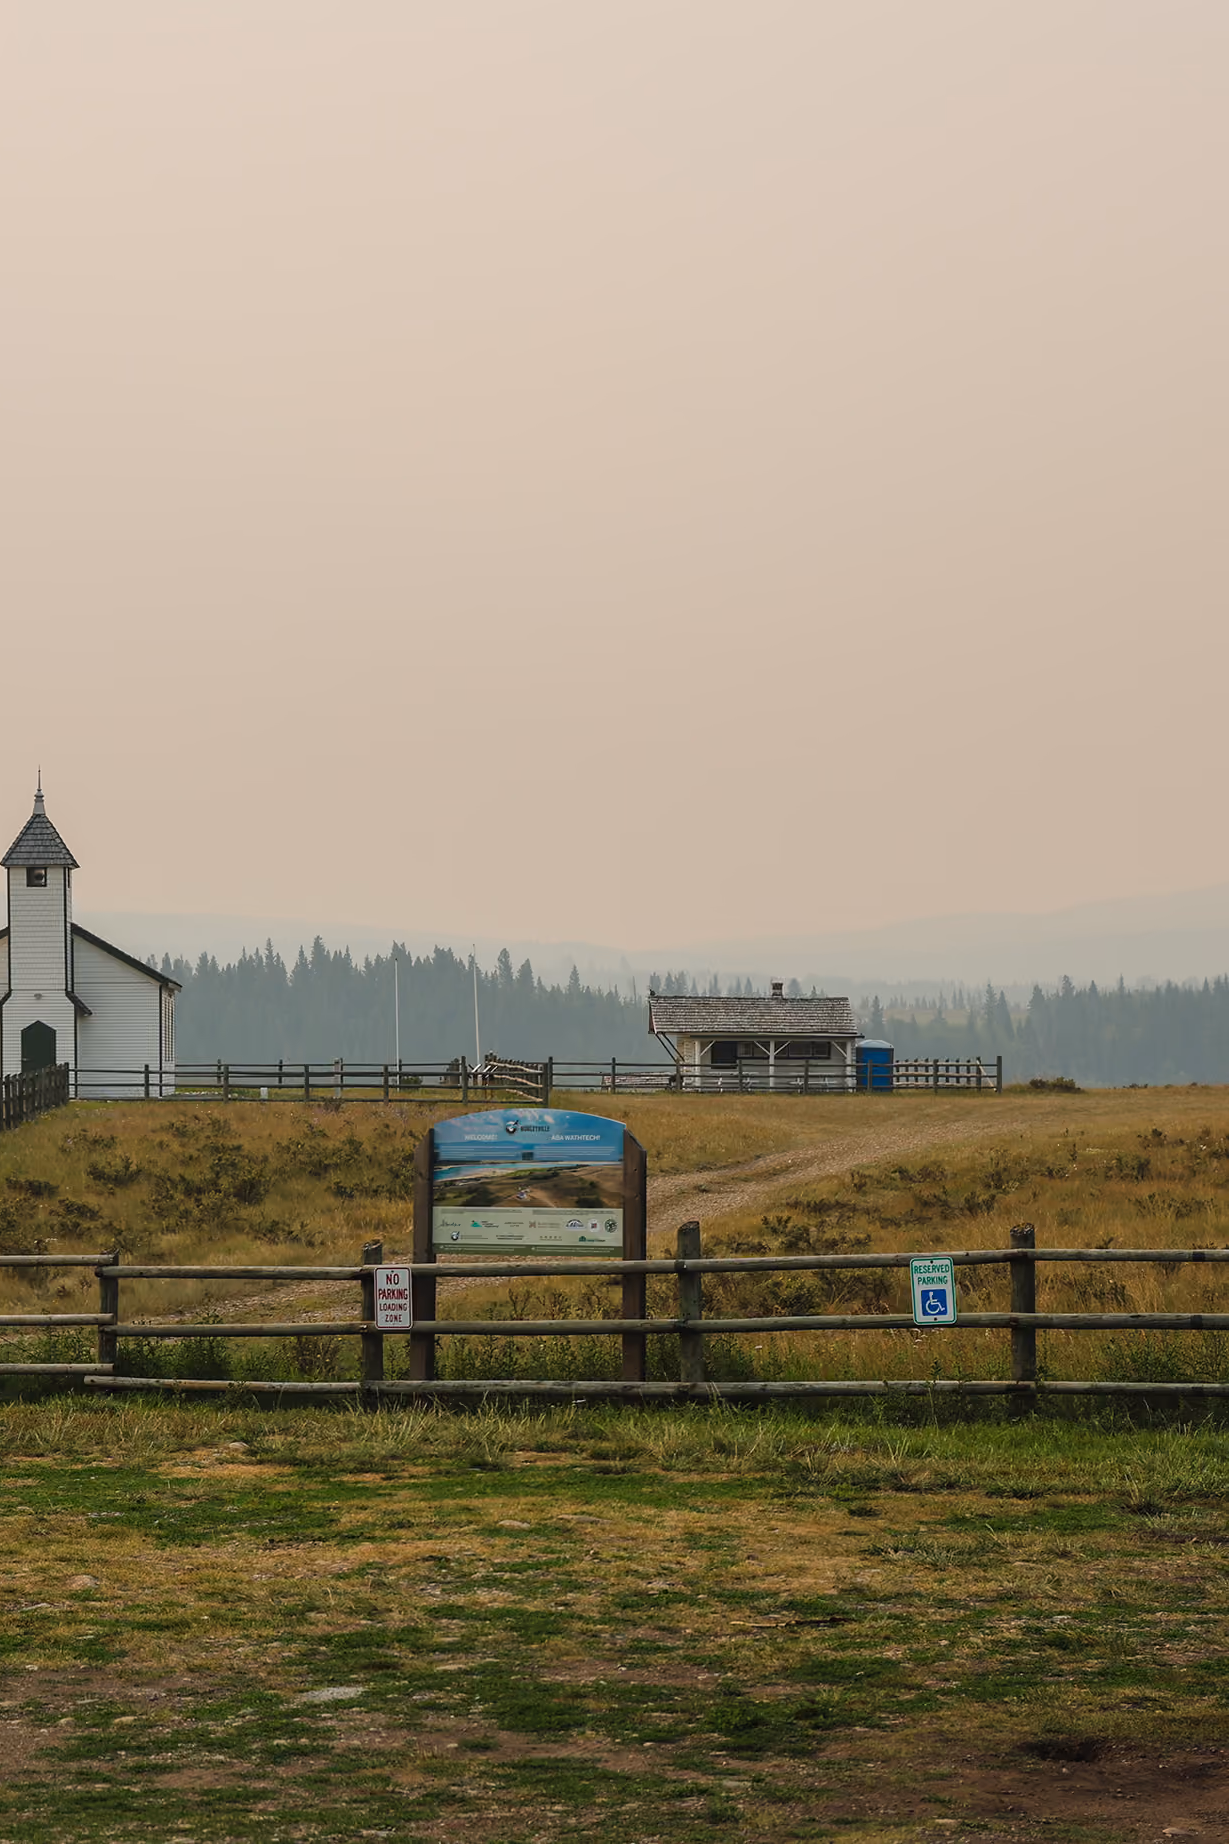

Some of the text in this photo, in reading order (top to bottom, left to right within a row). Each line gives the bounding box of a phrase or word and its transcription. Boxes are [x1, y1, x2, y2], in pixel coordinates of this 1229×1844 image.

[913, 1264, 950, 1274] RESERVED
[386, 1273, 400, 1285] NO
[917, 1275, 948, 1286] PARKING
[378, 1288, 408, 1300] PARKING
[379, 1302, 408, 1312] LOADING
[385, 1314, 402, 1323] ZONE
